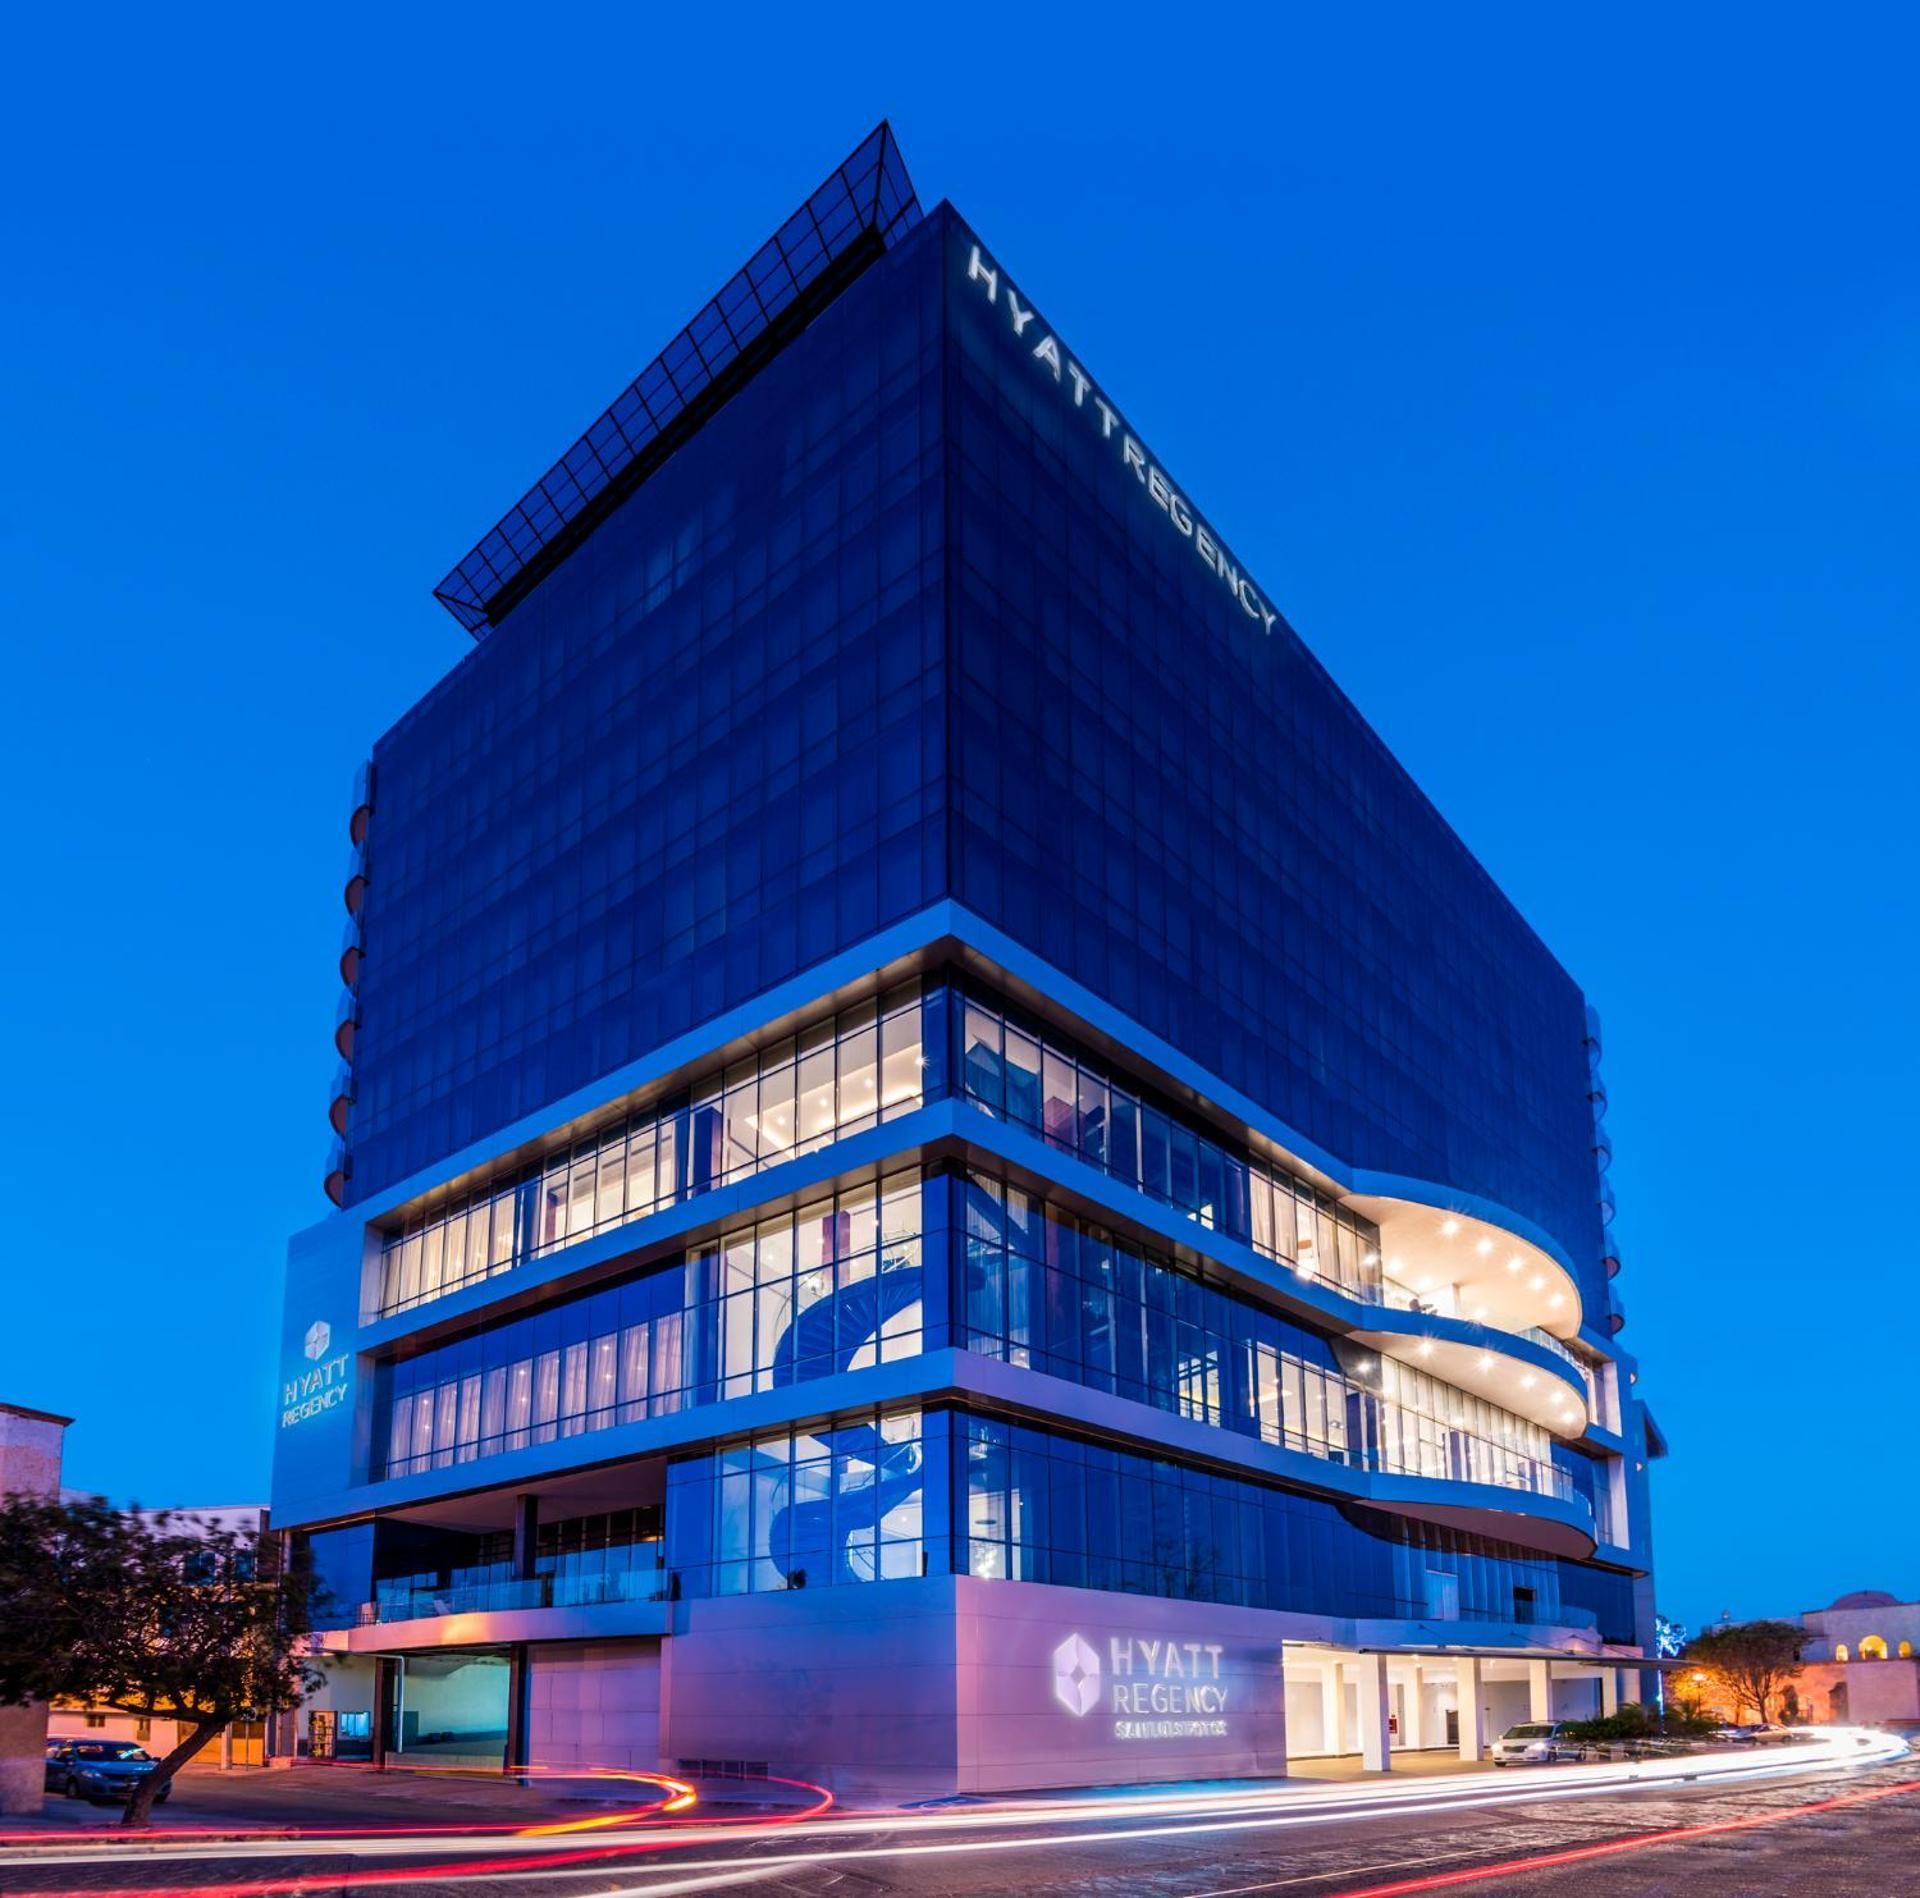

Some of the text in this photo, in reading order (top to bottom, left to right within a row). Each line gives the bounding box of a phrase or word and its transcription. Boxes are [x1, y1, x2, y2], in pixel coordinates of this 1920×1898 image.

[967, 244, 1277, 635] HYATT REGENCY
[284, 1353, 349, 1406] HYATT
[281, 1383, 348, 1428] REGENCY
[1110, 1636, 1225, 1680] HYATT
[1112, 1682, 1229, 1714] REGENCY
